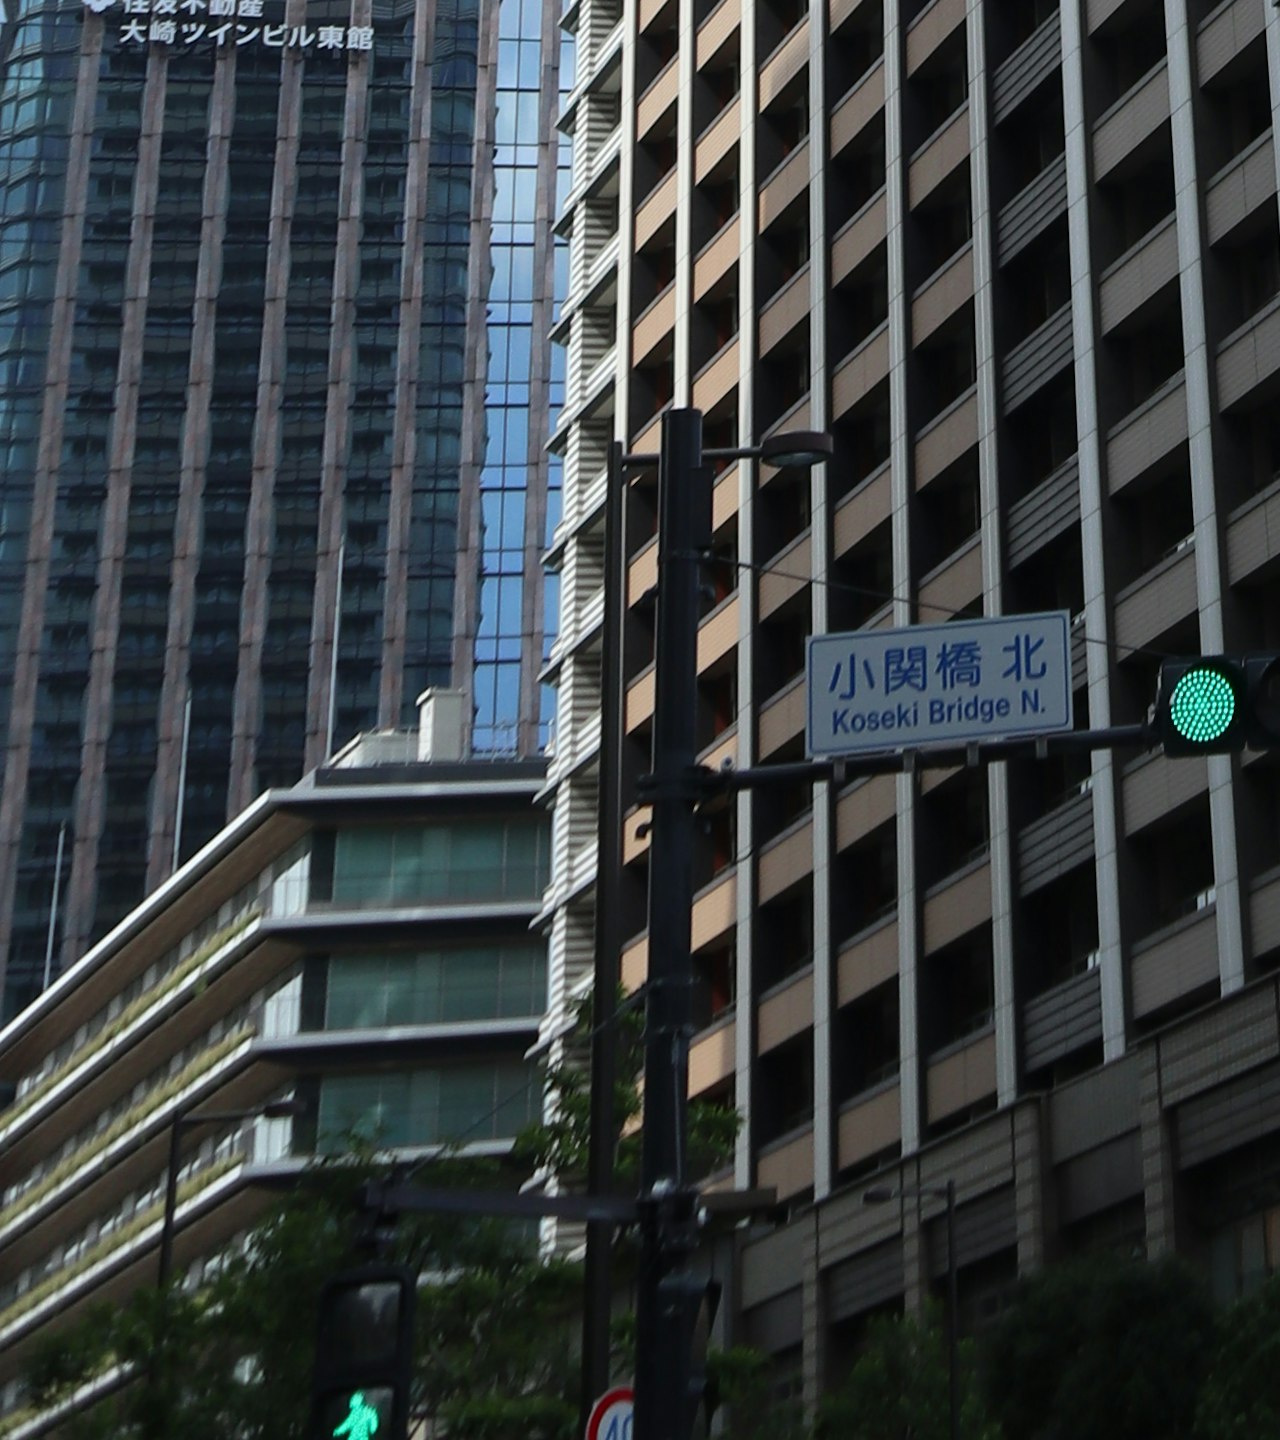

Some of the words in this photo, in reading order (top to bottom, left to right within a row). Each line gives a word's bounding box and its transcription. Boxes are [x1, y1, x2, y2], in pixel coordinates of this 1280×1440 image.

[119, 19, 374, 50] 大崎ツインビル東館
[829, 640, 982, 700] 小関橋
[1002, 633, 1047, 682] 北
[832, 701, 919, 735] Koseki
[929, 695, 1010, 725] Bridge
[1021, 688, 1046, 715] N.
